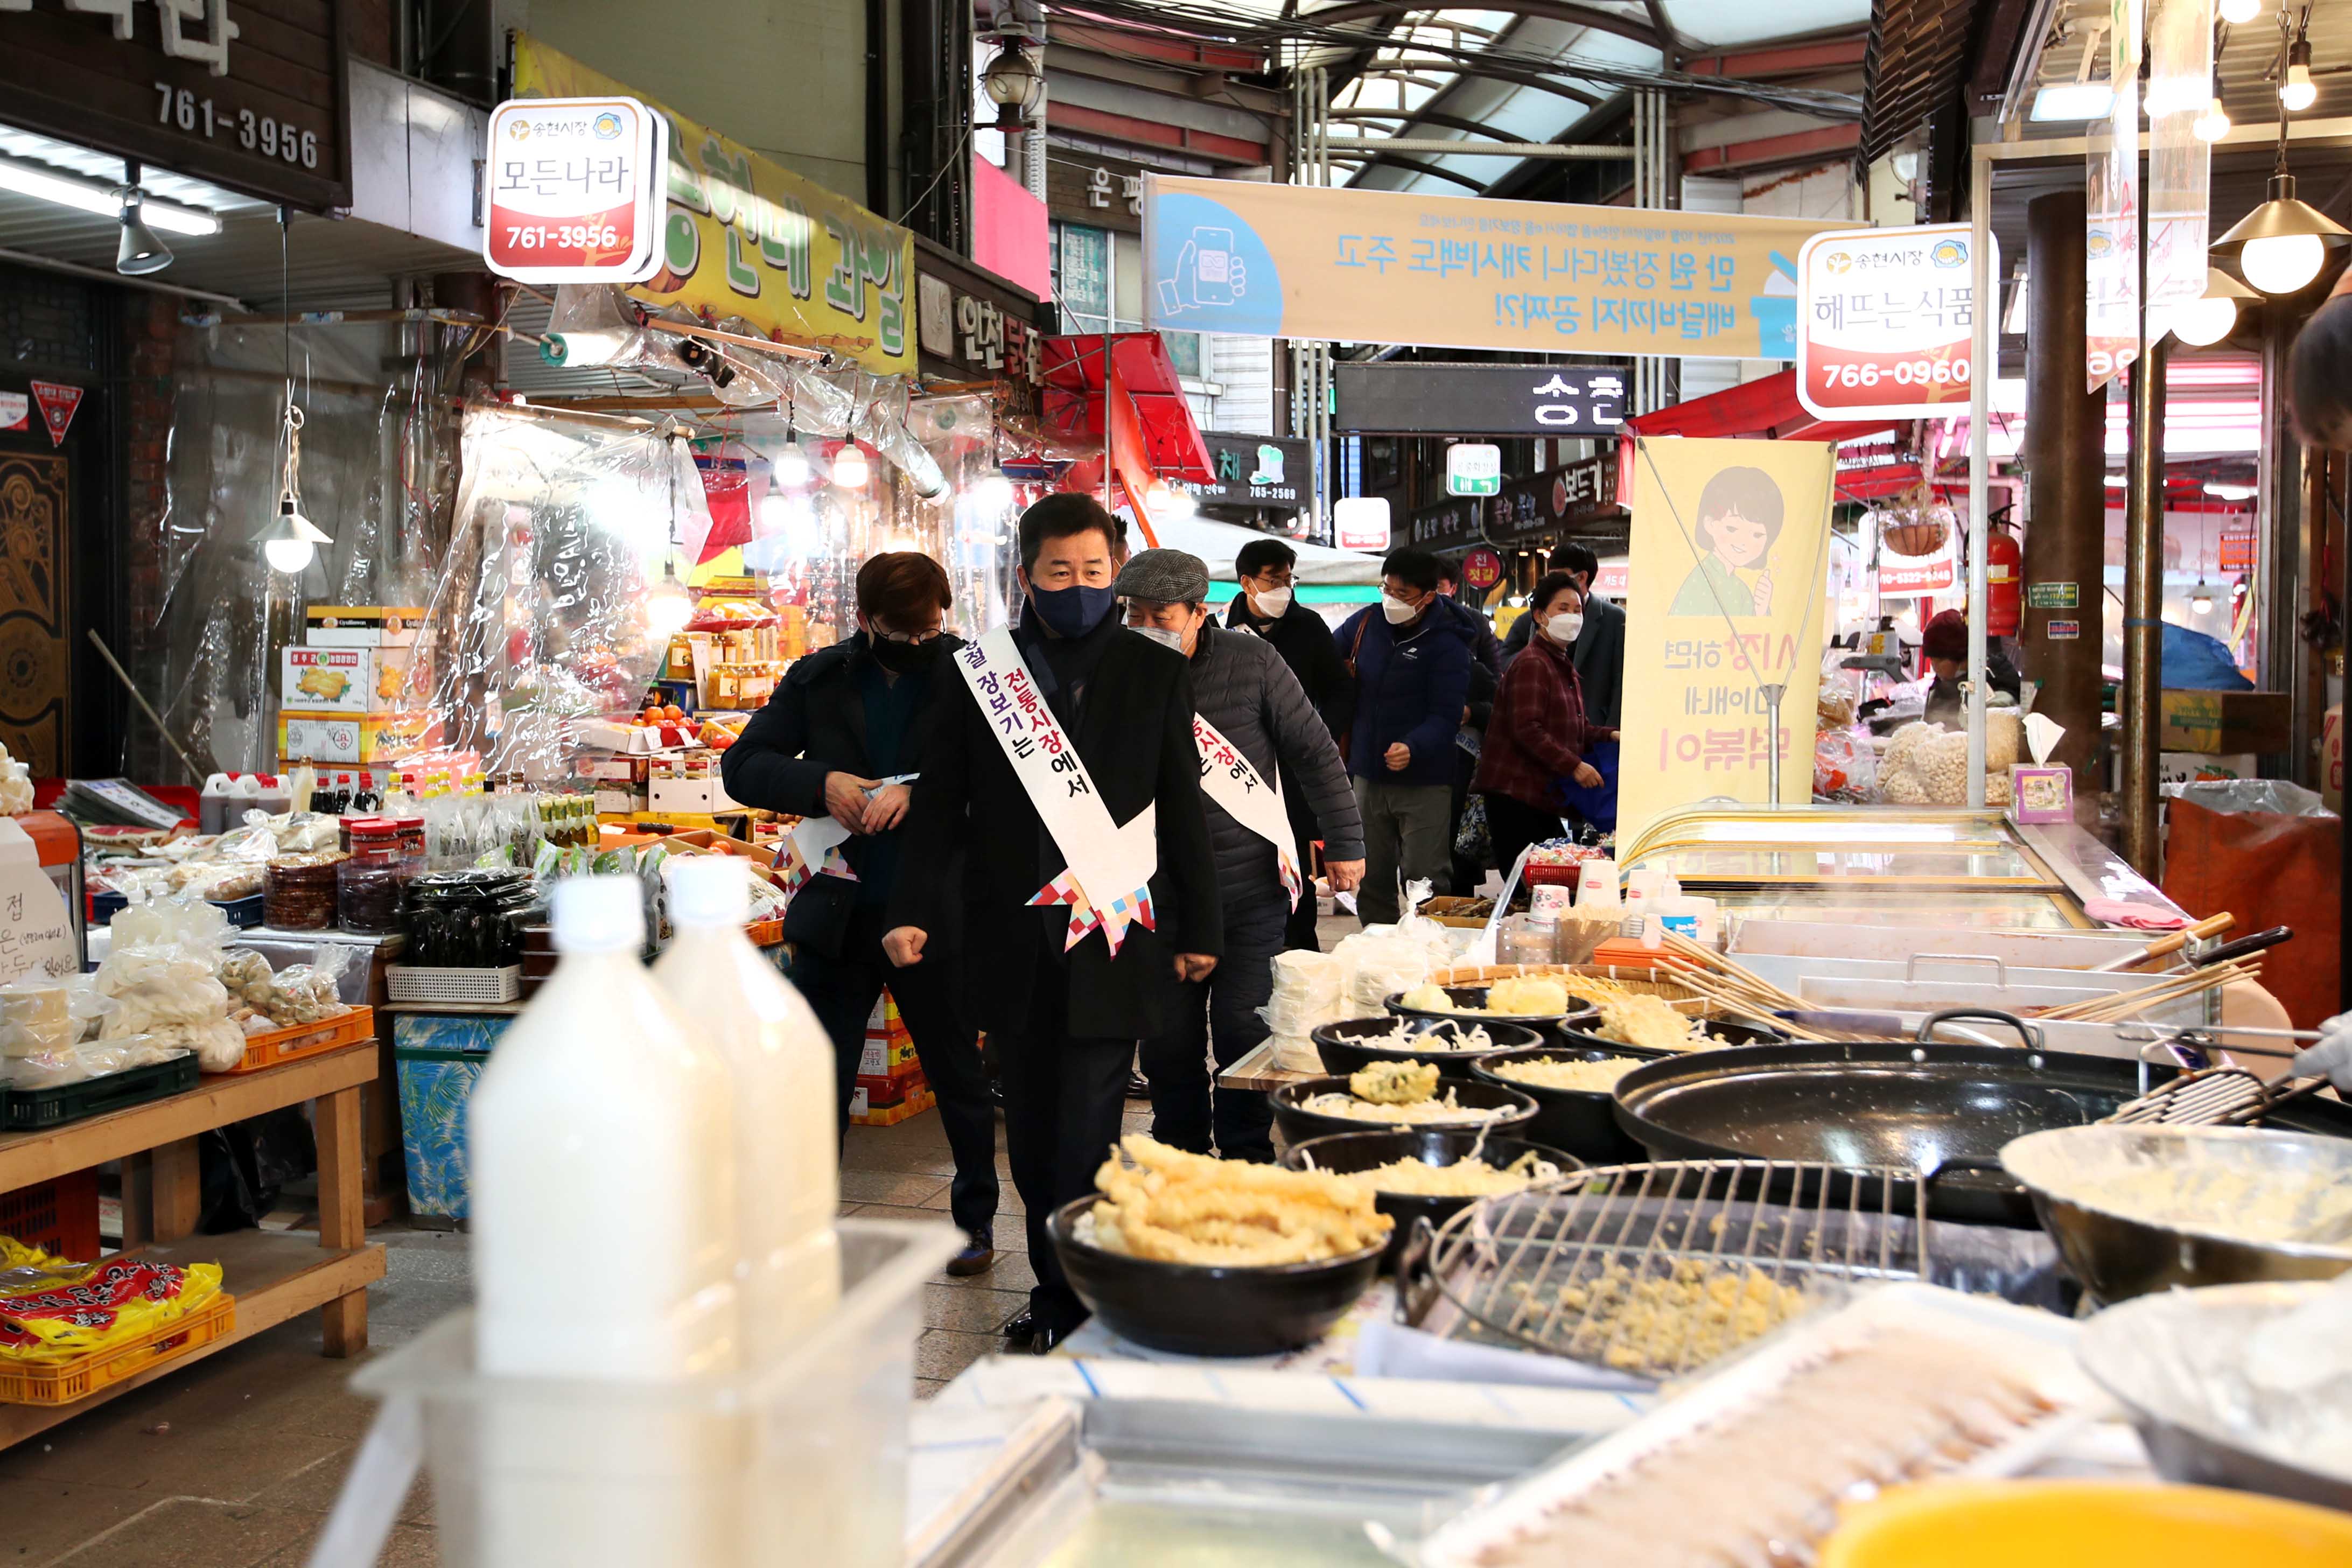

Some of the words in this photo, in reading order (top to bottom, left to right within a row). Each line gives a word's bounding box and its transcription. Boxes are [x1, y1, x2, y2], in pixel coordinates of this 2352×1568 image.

[155, 82, 317, 169] 761-3956
[533, 121, 587, 137] 송현시장
[499, 156, 629, 195] 모든나라
[506, 226, 617, 249] 761-3956
[1856, 251, 1923, 269] 송현시장
[824, 211, 904, 356] 과일
[1815, 288, 1972, 331] 해뜨는식품
[1822, 359, 1970, 388] 766-0960
[1250, 486, 1296, 500] 765-2569
[976, 670, 1035, 759] 장보기는
[1004, 667, 1090, 797] 전통시장에서
